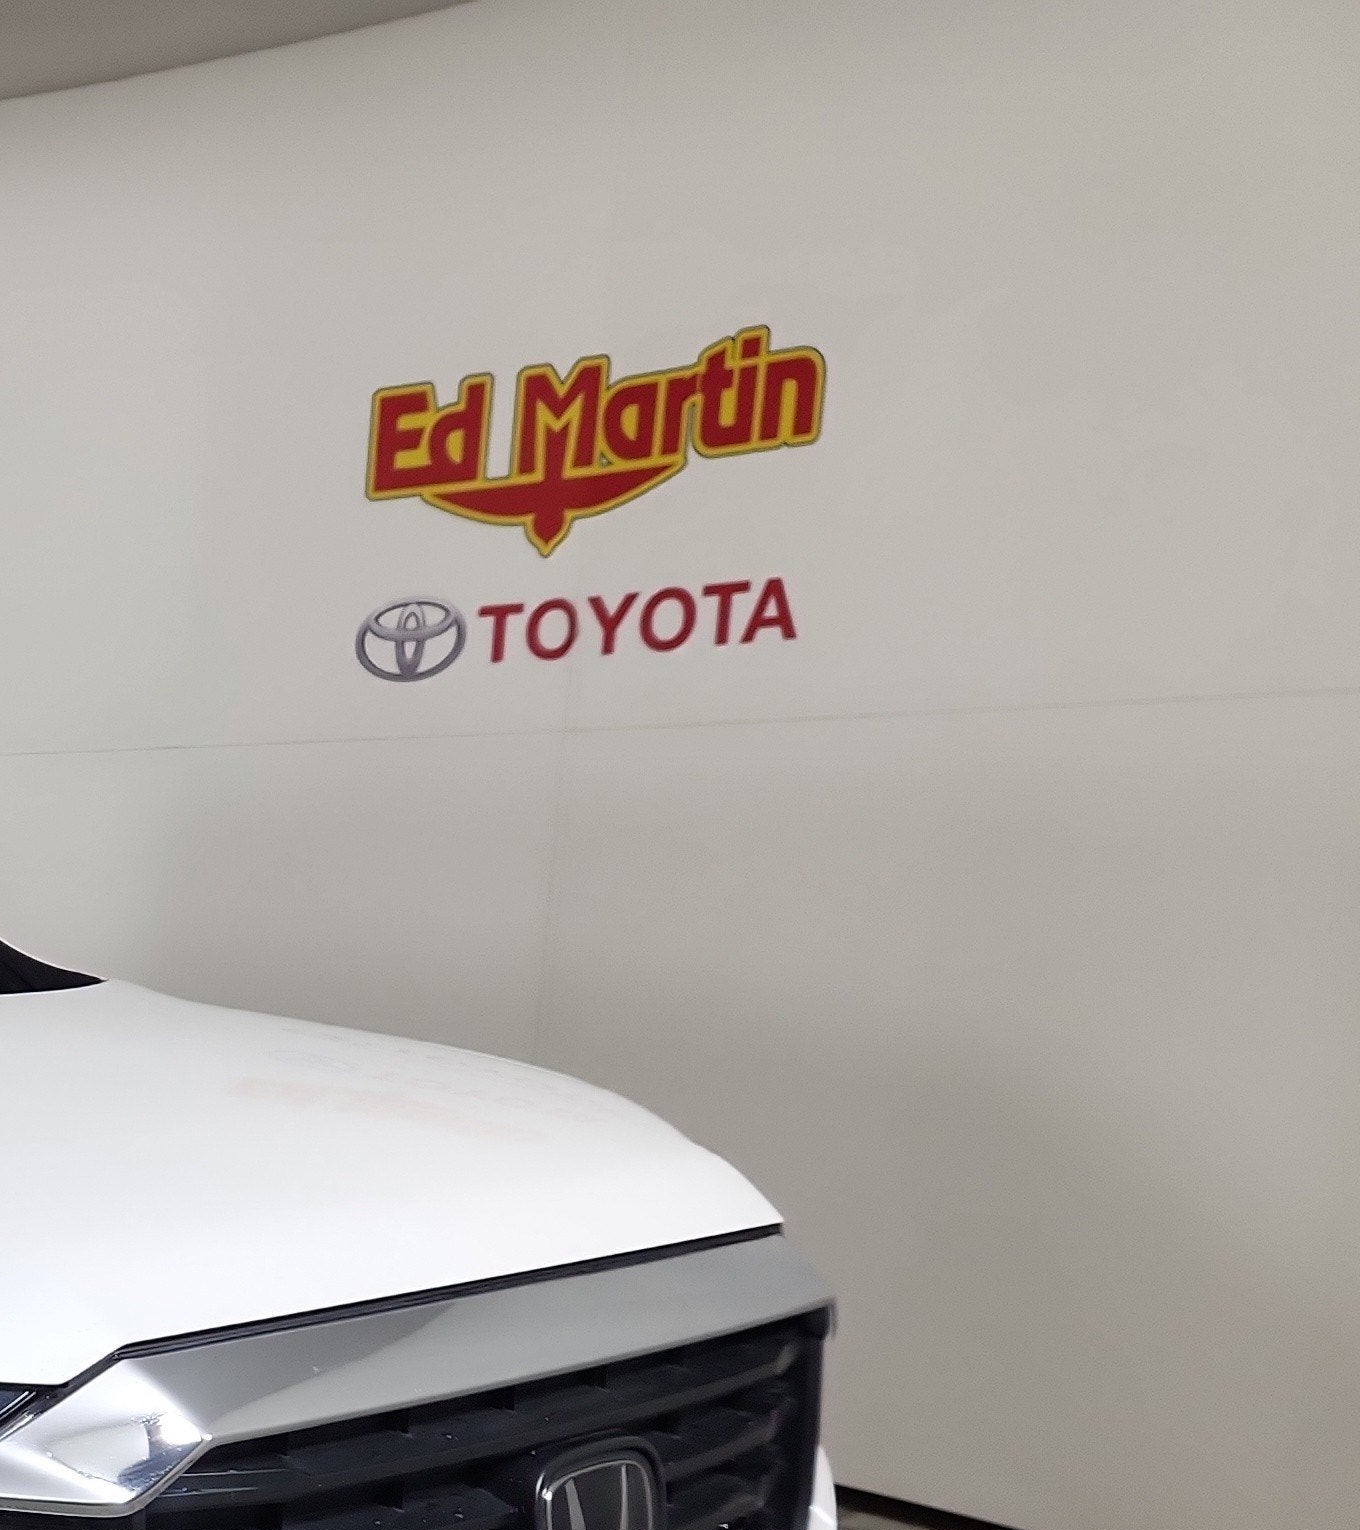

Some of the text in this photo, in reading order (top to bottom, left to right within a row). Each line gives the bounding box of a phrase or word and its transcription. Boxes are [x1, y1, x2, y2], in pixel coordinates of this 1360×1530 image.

[374, 336, 818, 491] Ed Martin
[477, 577, 797, 663] TOYOTA
